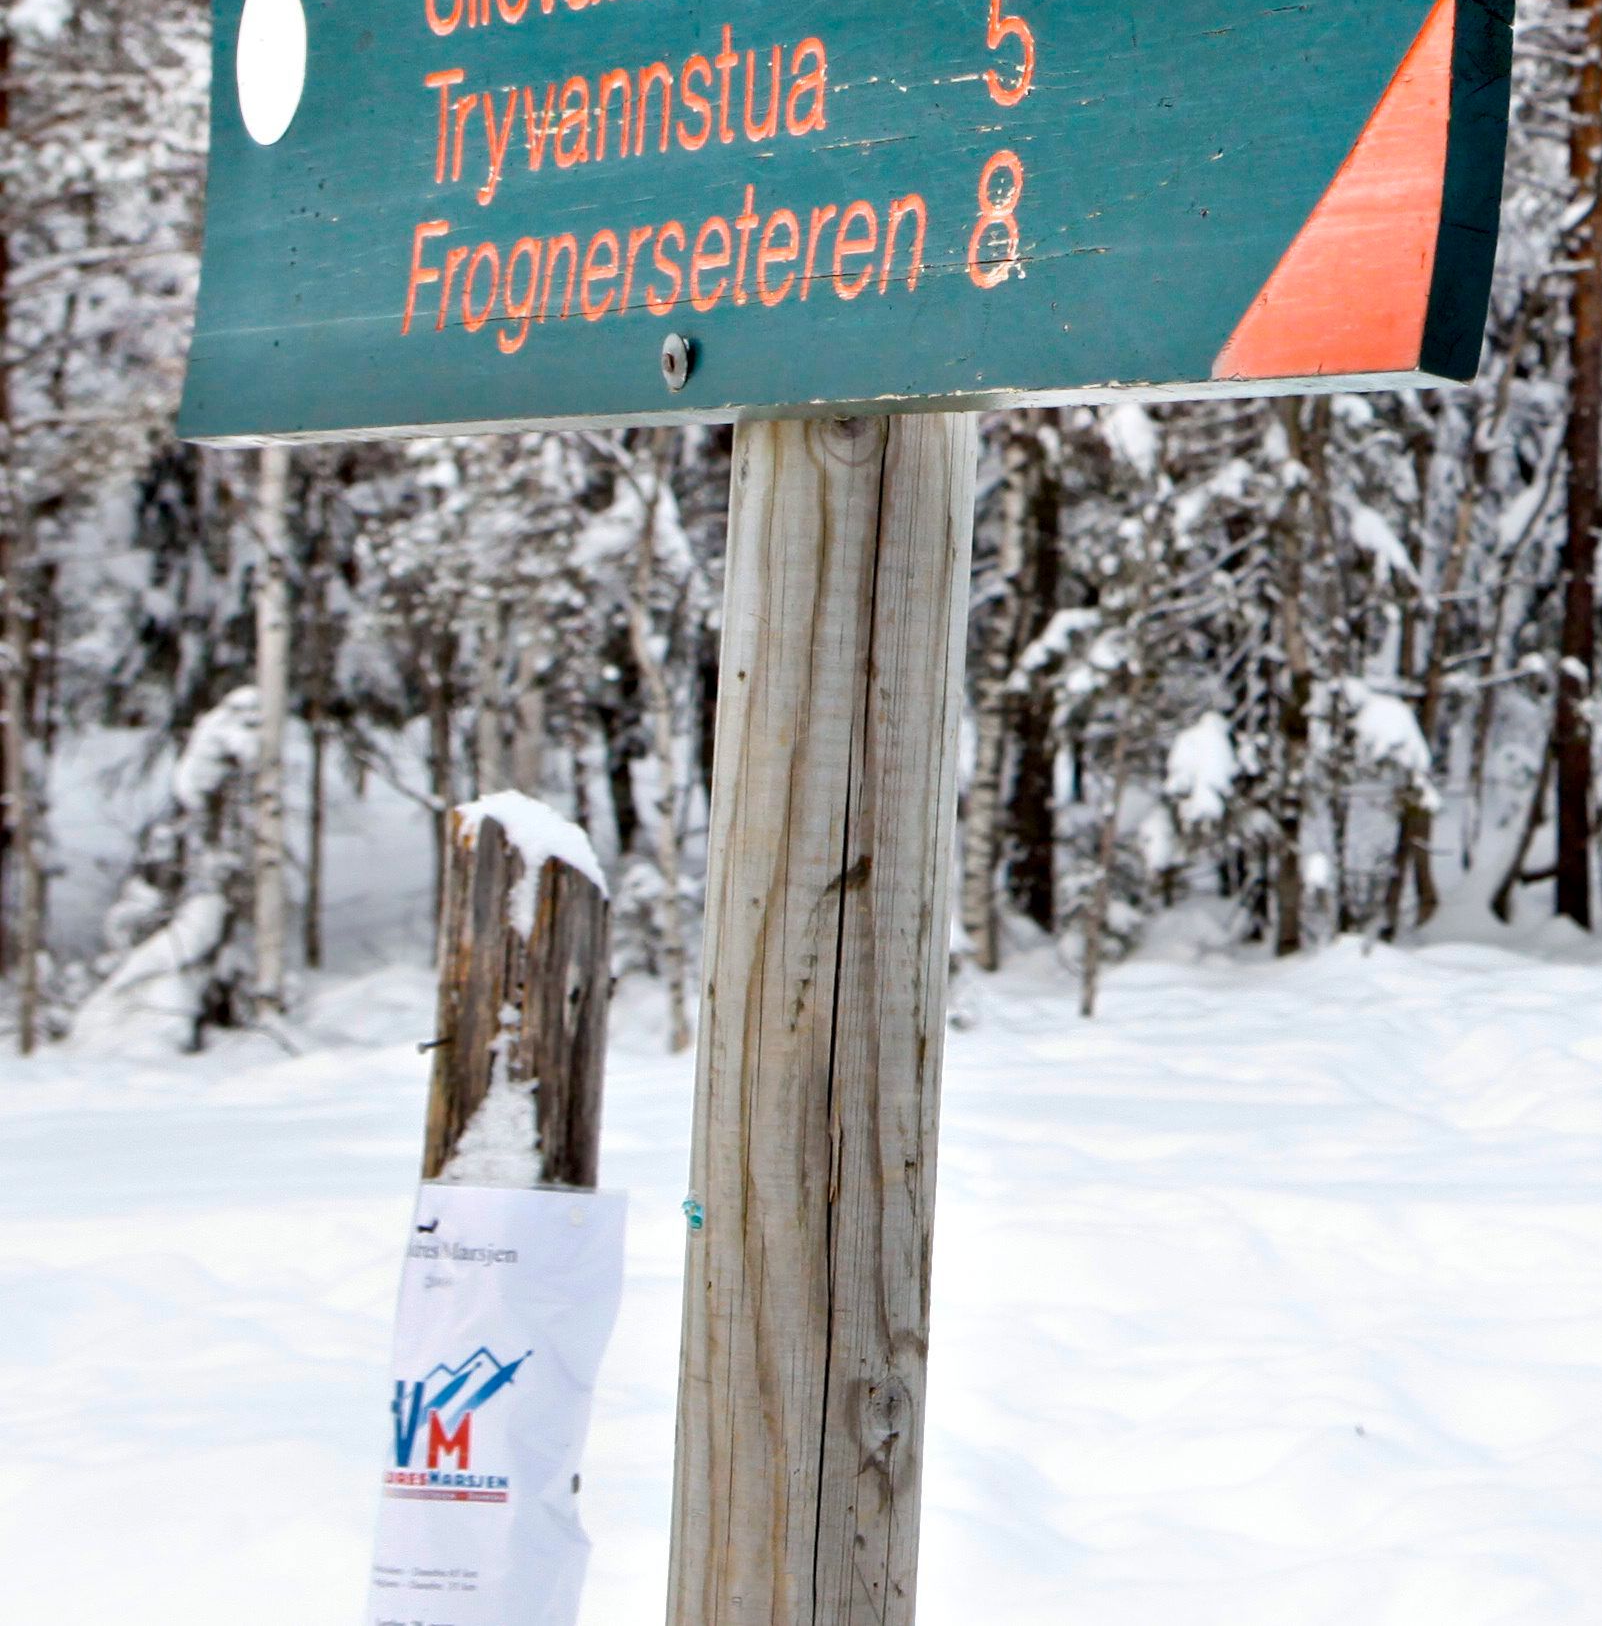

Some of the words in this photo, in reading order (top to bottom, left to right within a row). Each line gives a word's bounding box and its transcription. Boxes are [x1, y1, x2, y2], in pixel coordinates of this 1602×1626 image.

[423, 23, 829, 207] Tryvannstua
[401, 182, 928, 354] Frognerseteren
[966, 149, 1025, 290] 8
